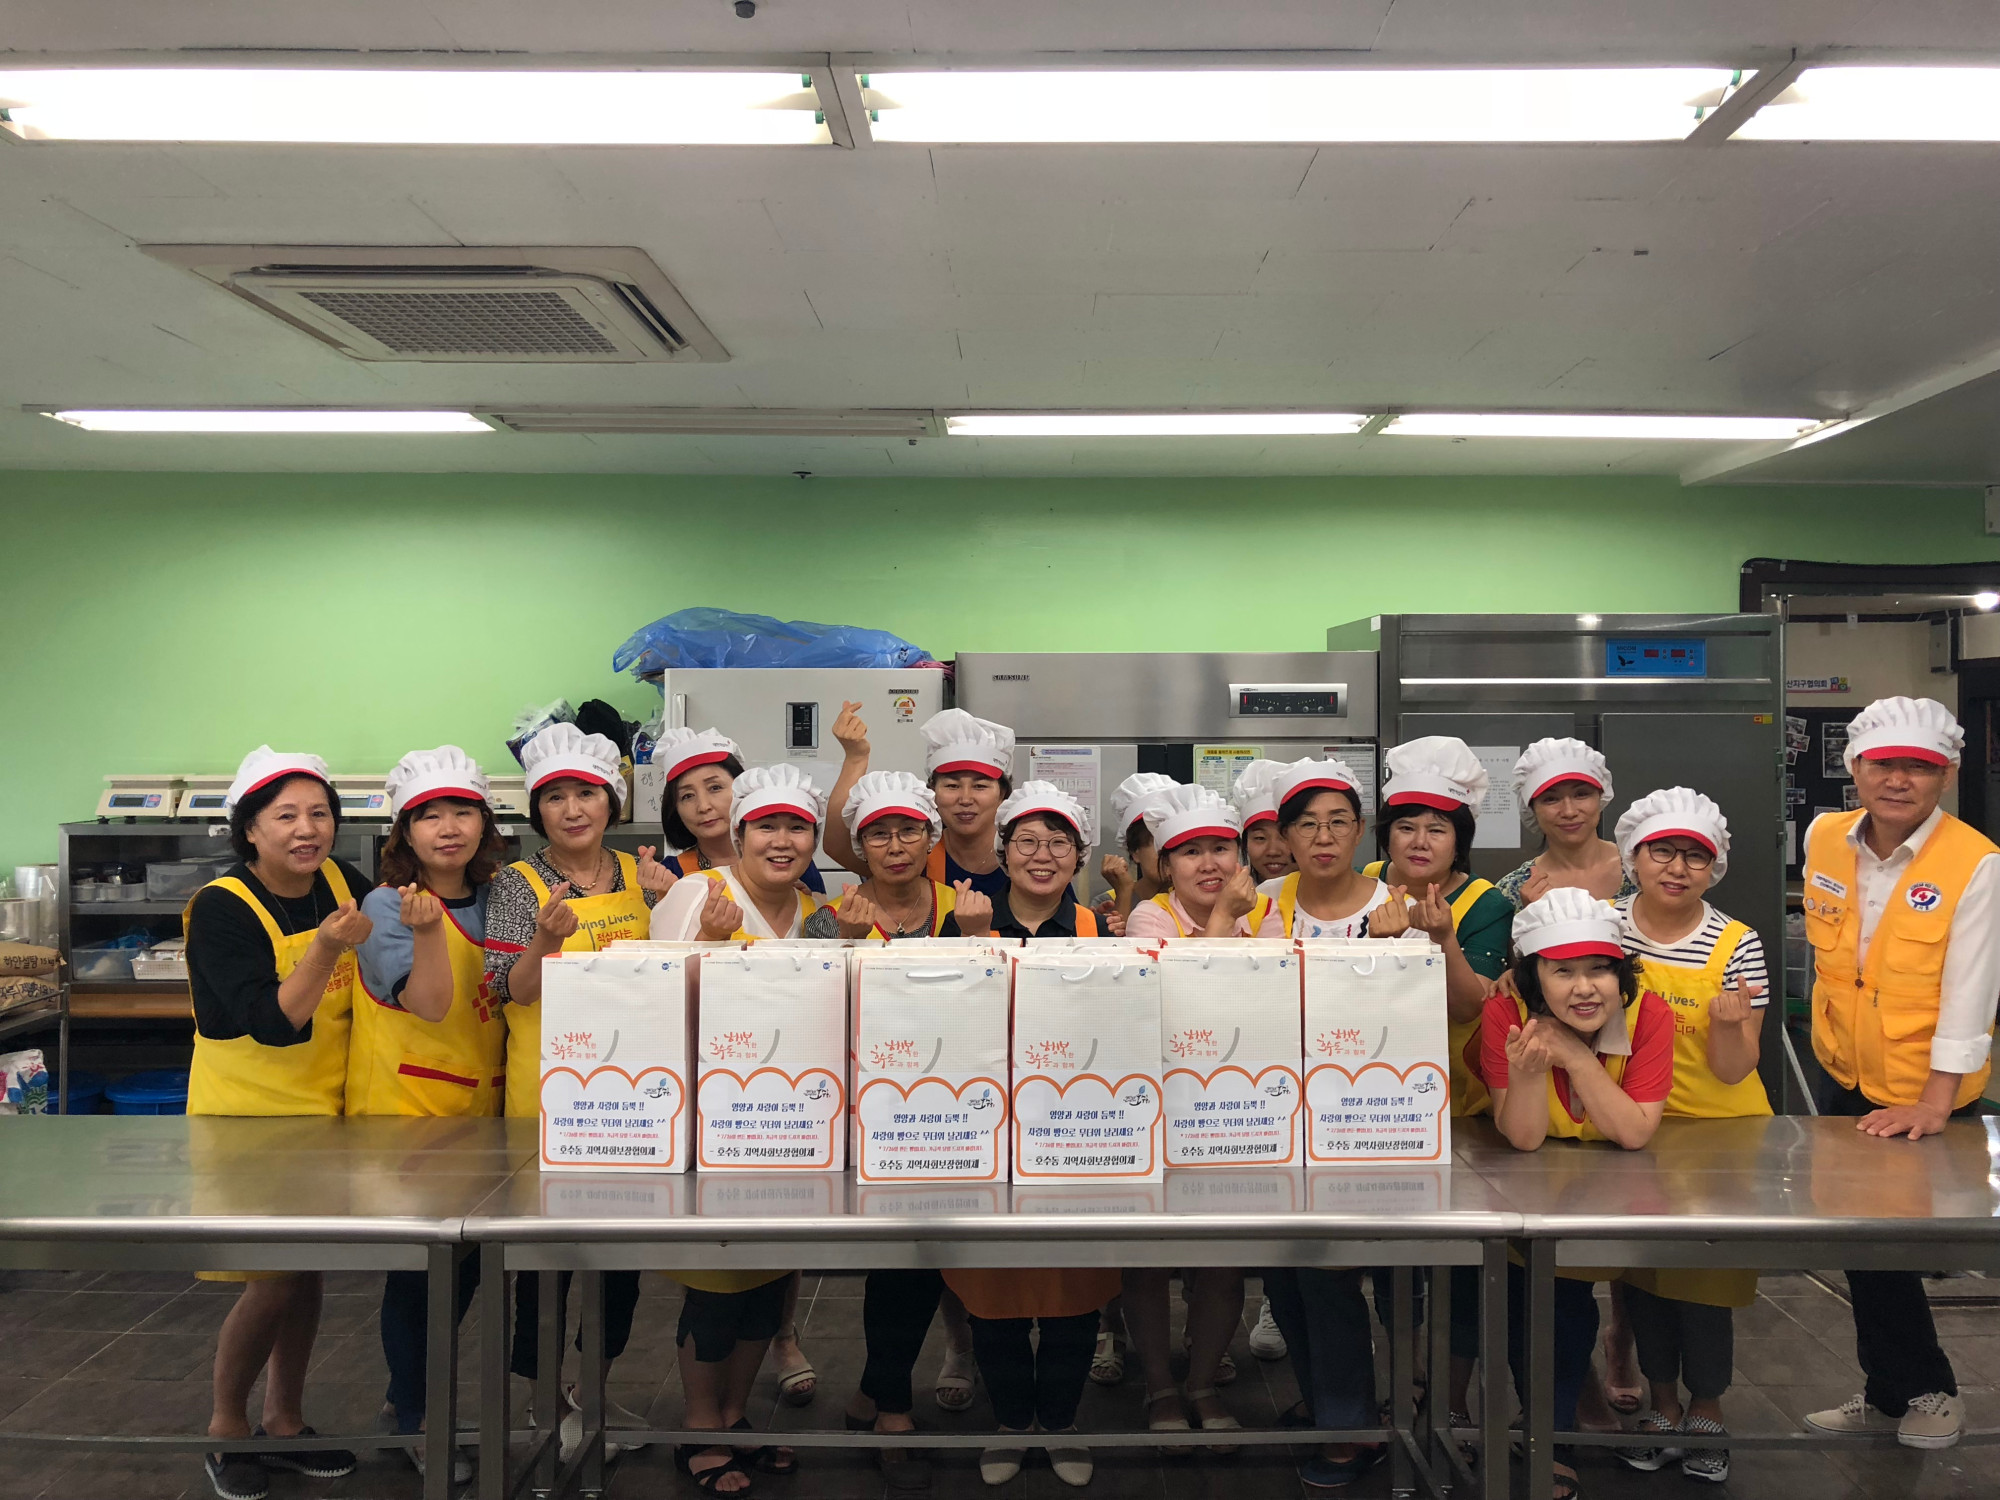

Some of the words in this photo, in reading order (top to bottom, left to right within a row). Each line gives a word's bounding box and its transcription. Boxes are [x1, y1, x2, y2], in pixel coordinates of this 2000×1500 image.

[576, 919, 606, 931] aving
[607, 912, 639, 926] Lives,
[596, 928, 633, 944] 적십자는
[573, 1101, 594, 1110] 영양과
[598, 1102, 619, 1110] 사랑이
[622, 1102, 636, 1110] 듬뿍
[1194, 1101, 1216, 1111] 영양과
[1219, 1101, 1240, 1110] 사랑이
[1244, 1101, 1257, 1110] 듬뿍
[1341, 1097, 1362, 1106] 영양과
[1366, 1097, 1388, 1106] 사랑이
[1391, 1097, 1405, 1106] 듬뿍
[732, 1103, 753, 1112] 영양과
[756, 1103, 778, 1112] 사랑이
[782, 1103, 796, 1112] 듬뿍
[894, 1114, 916, 1123] 영양과
[919, 1114, 941, 1123] 사랑이
[945, 1114, 959, 1123] 듬뿍
[1050, 1110, 1072, 1119] 영양과
[1076, 1111, 1098, 1120] 사랑이
[1102, 1110, 1116, 1119] 듬뿍
[1320, 1114, 1342, 1122] 사랑의
[1345, 1114, 1366, 1122] 빵으로
[1370, 1114, 1390, 1123] 무더위
[1394, 1114, 1422, 1123] 날리세요
[553, 1118, 574, 1126] 사랑의
[577, 1118, 598, 1127] 빵으로
[602, 1119, 622, 1127] 무더위
[625, 1119, 653, 1128] 날리세요
[710, 1120, 732, 1128] 사랑의
[735, 1120, 757, 1129] 빵으로
[761, 1120, 781, 1129] 무더위
[784, 1120, 813, 1129] 날리세요
[1173, 1119, 1195, 1128] 사랑의
[1198, 1119, 1219, 1128] 빵으로
[1223, 1118, 1244, 1127] 무더위
[1247, 1117, 1274, 1126] 날리세요
[872, 1132, 894, 1140] 사랑의
[897, 1132, 919, 1140] 빵으로
[923, 1132, 944, 1140] 무더위
[948, 1131, 977, 1140] 날리세요
[1028, 1128, 1050, 1136] 사랑의
[1054, 1128, 1076, 1137] 빵으로
[1080, 1128, 1101, 1137] 무더위
[1104, 1127, 1133, 1137] 날리세요
[1181, 1146, 1204, 1156] 호수동
[1208, 1144, 1277, 1155] 지역사회보장협의체
[1327, 1140, 1350, 1150] 호수동
[1354, 1140, 1424, 1150] 지역사회보장협의체
[560, 1145, 582, 1155] 호수동
[586, 1146, 655, 1156] 지역사회보장협의체
[717, 1147, 740, 1156] 호수동
[744, 1148, 815, 1157] 지역사회보장협의체
[879, 1160, 902, 1170] 호수동
[907, 1159, 979, 1169] 지역사회보장협의체
[1035, 1156, 1058, 1166] 호수동
[1063, 1155, 1135, 1166] 지역사회보장협의체
